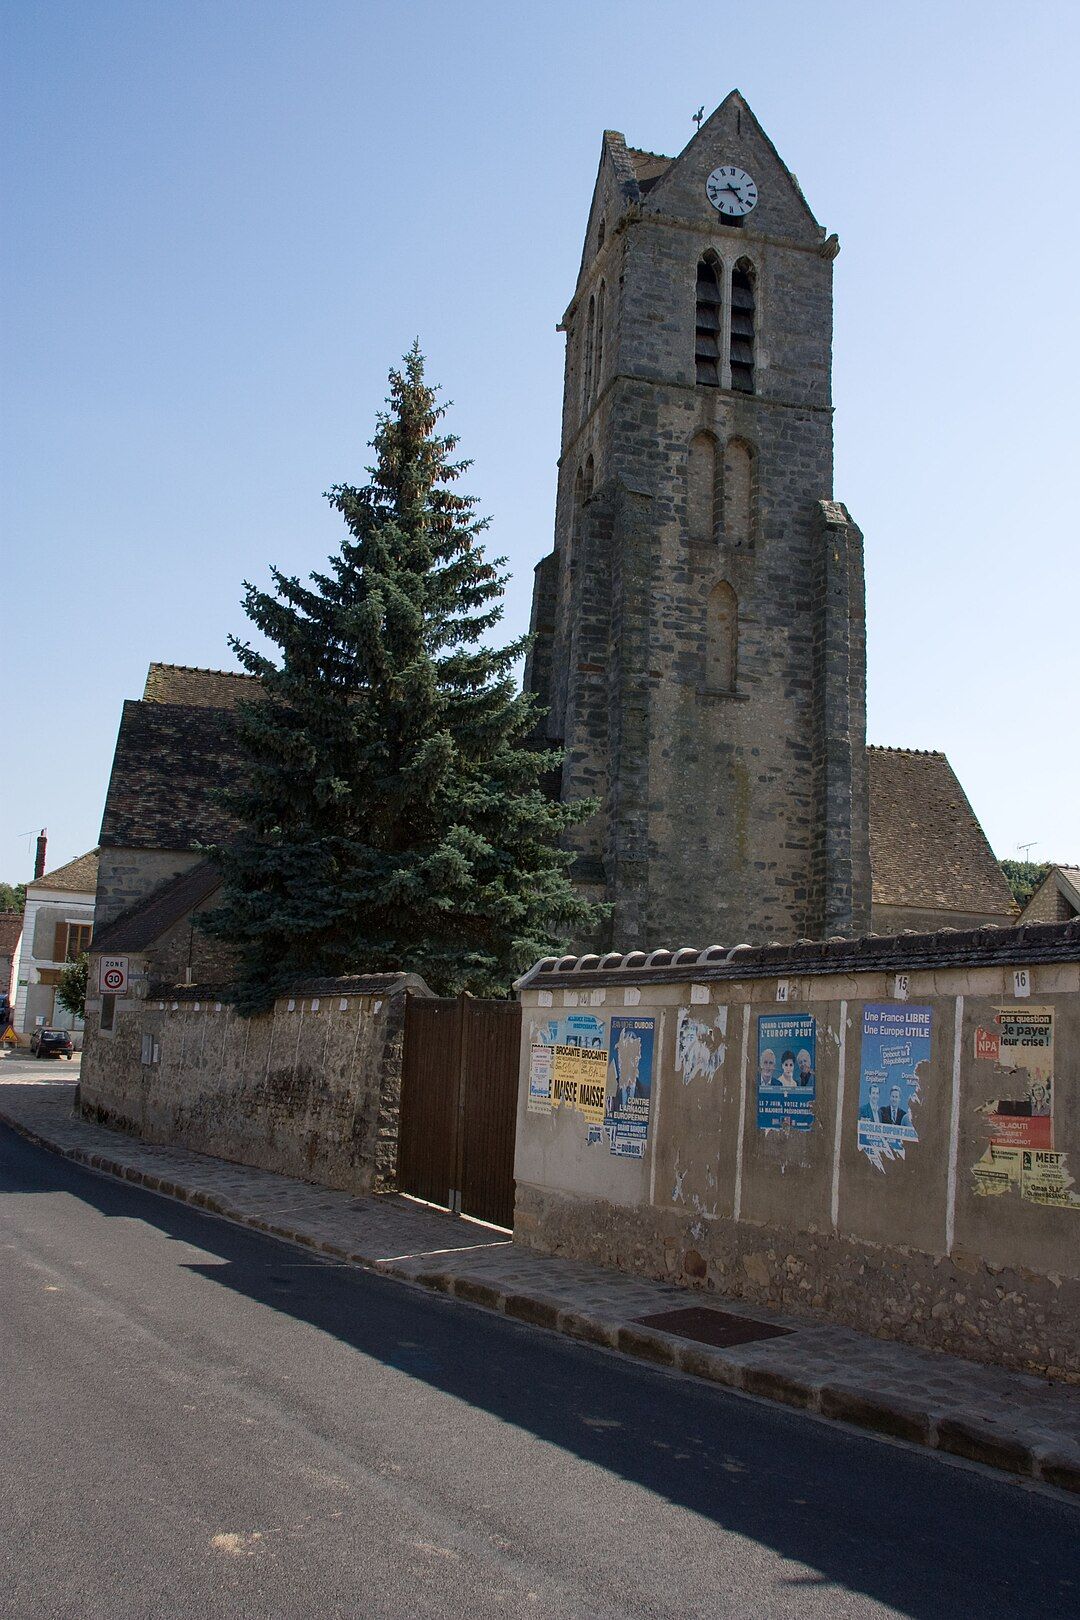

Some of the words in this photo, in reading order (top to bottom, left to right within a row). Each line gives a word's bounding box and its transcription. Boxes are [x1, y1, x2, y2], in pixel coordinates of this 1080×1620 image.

[108, 975, 120, 983] 30
[899, 976, 908, 990] 15
[1015, 972, 1026, 987] 16
[778, 987, 786, 999] 14
[864, 1012, 879, 1021] Une
[880, 1013, 904, 1022] France
[905, 1014, 930, 1024] LIBRE
[1000, 1016, 1015, 1024] pas
[1016, 1015, 1050, 1024] question
[634, 1021, 654, 1029] DUBOIS
[777, 1021, 800, 1029] L'EUROPE
[800, 1020, 812, 1028] VEUT
[761, 1029, 792, 1037] L'EUROPE
[795, 1028, 812, 1037] PEUT
[864, 1025, 878, 1034] Une
[879, 1026, 904, 1037] Europe
[905, 1028, 930, 1038] UTILE
[1017, 1026, 1050, 1038] payer
[979, 1040, 998, 1052] NPA
[1000, 1037, 1019, 1046] leur
[1022, 1036, 1044, 1046] crise
[555, 1045, 581, 1058] BROCANTE
[581, 1049, 608, 1062] BROCANTE
[579, 1084, 605, 1108] MAISSE
[627, 1096, 650, 1106] CONTRE
[619, 1103, 649, 1115] L'ARNAQUE
